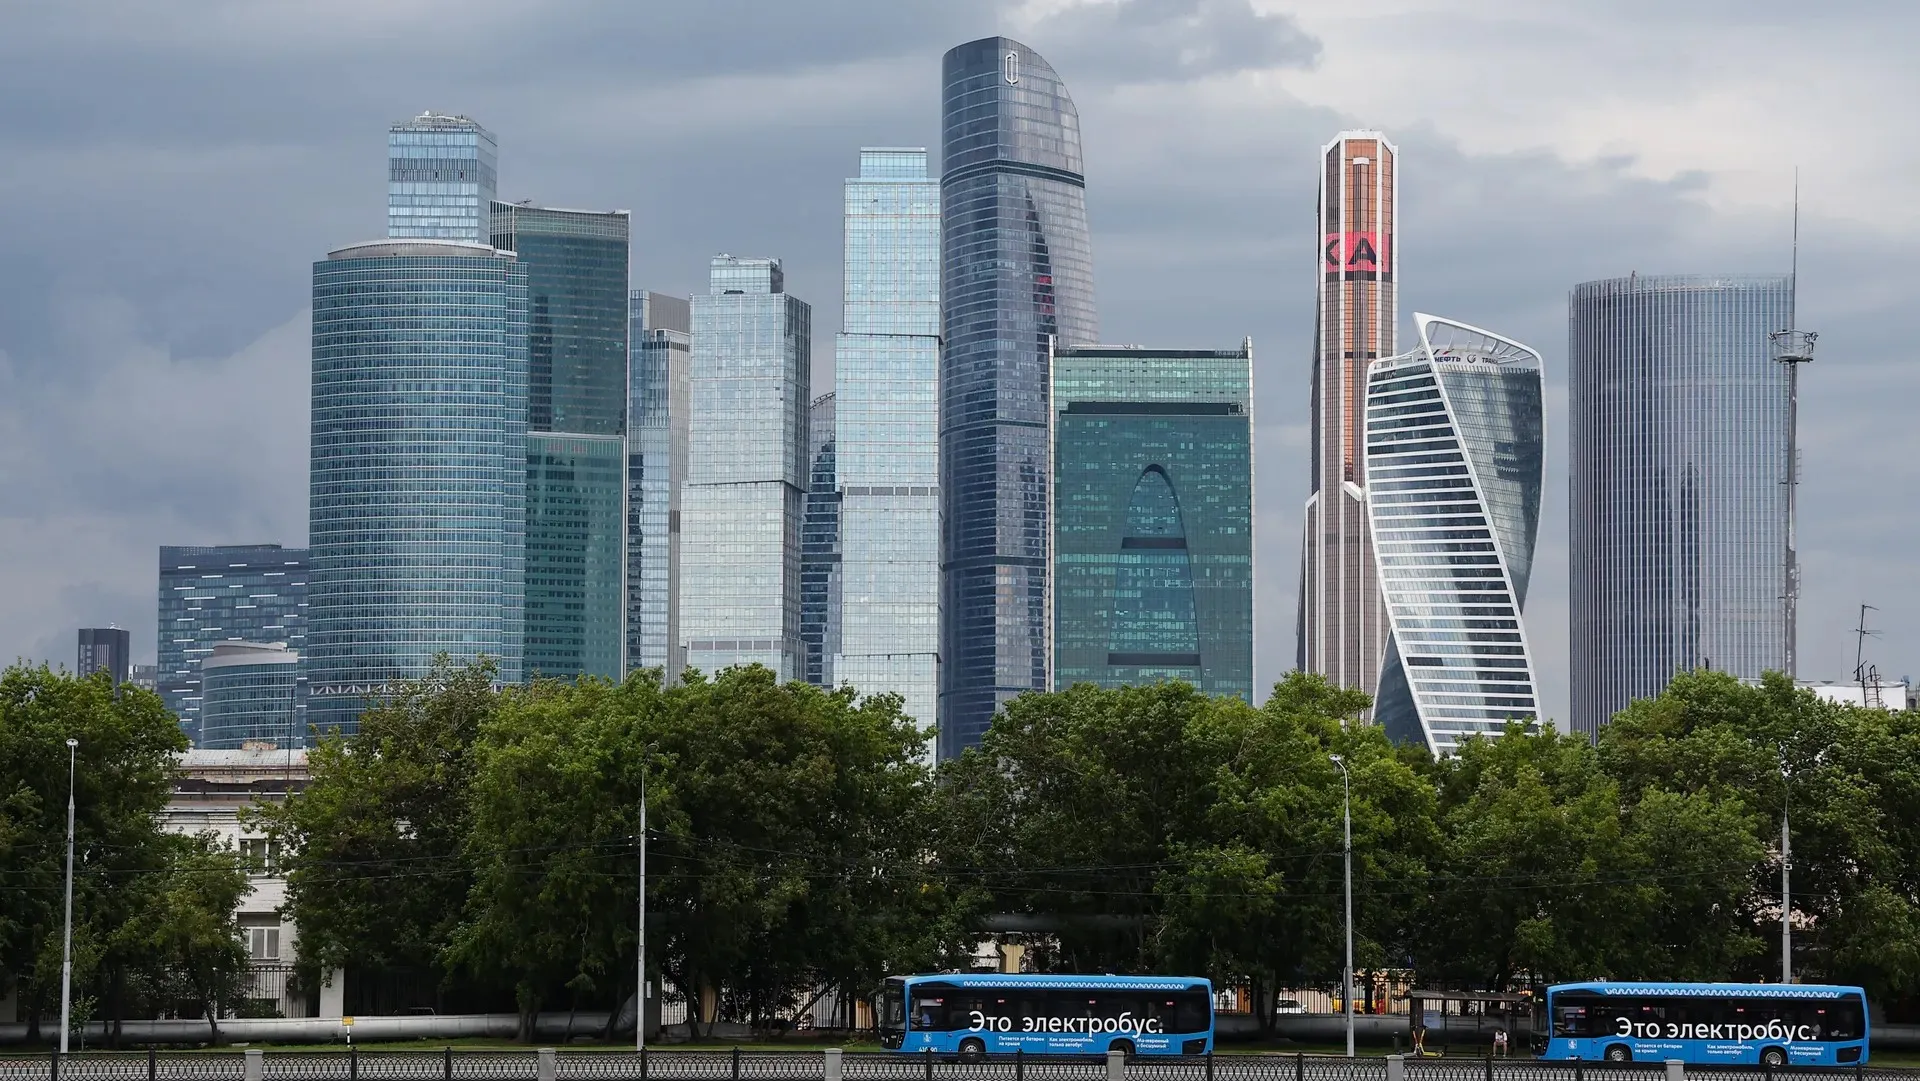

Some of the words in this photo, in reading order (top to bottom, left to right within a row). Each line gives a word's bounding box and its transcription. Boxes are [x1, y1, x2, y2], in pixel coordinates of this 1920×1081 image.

[968, 1010, 1012, 1033] Это
[1022, 1011, 1163, 1039] электробус.
[1615, 1016, 1660, 1038] Это
[1666, 1018, 1817, 1045] электробус.
